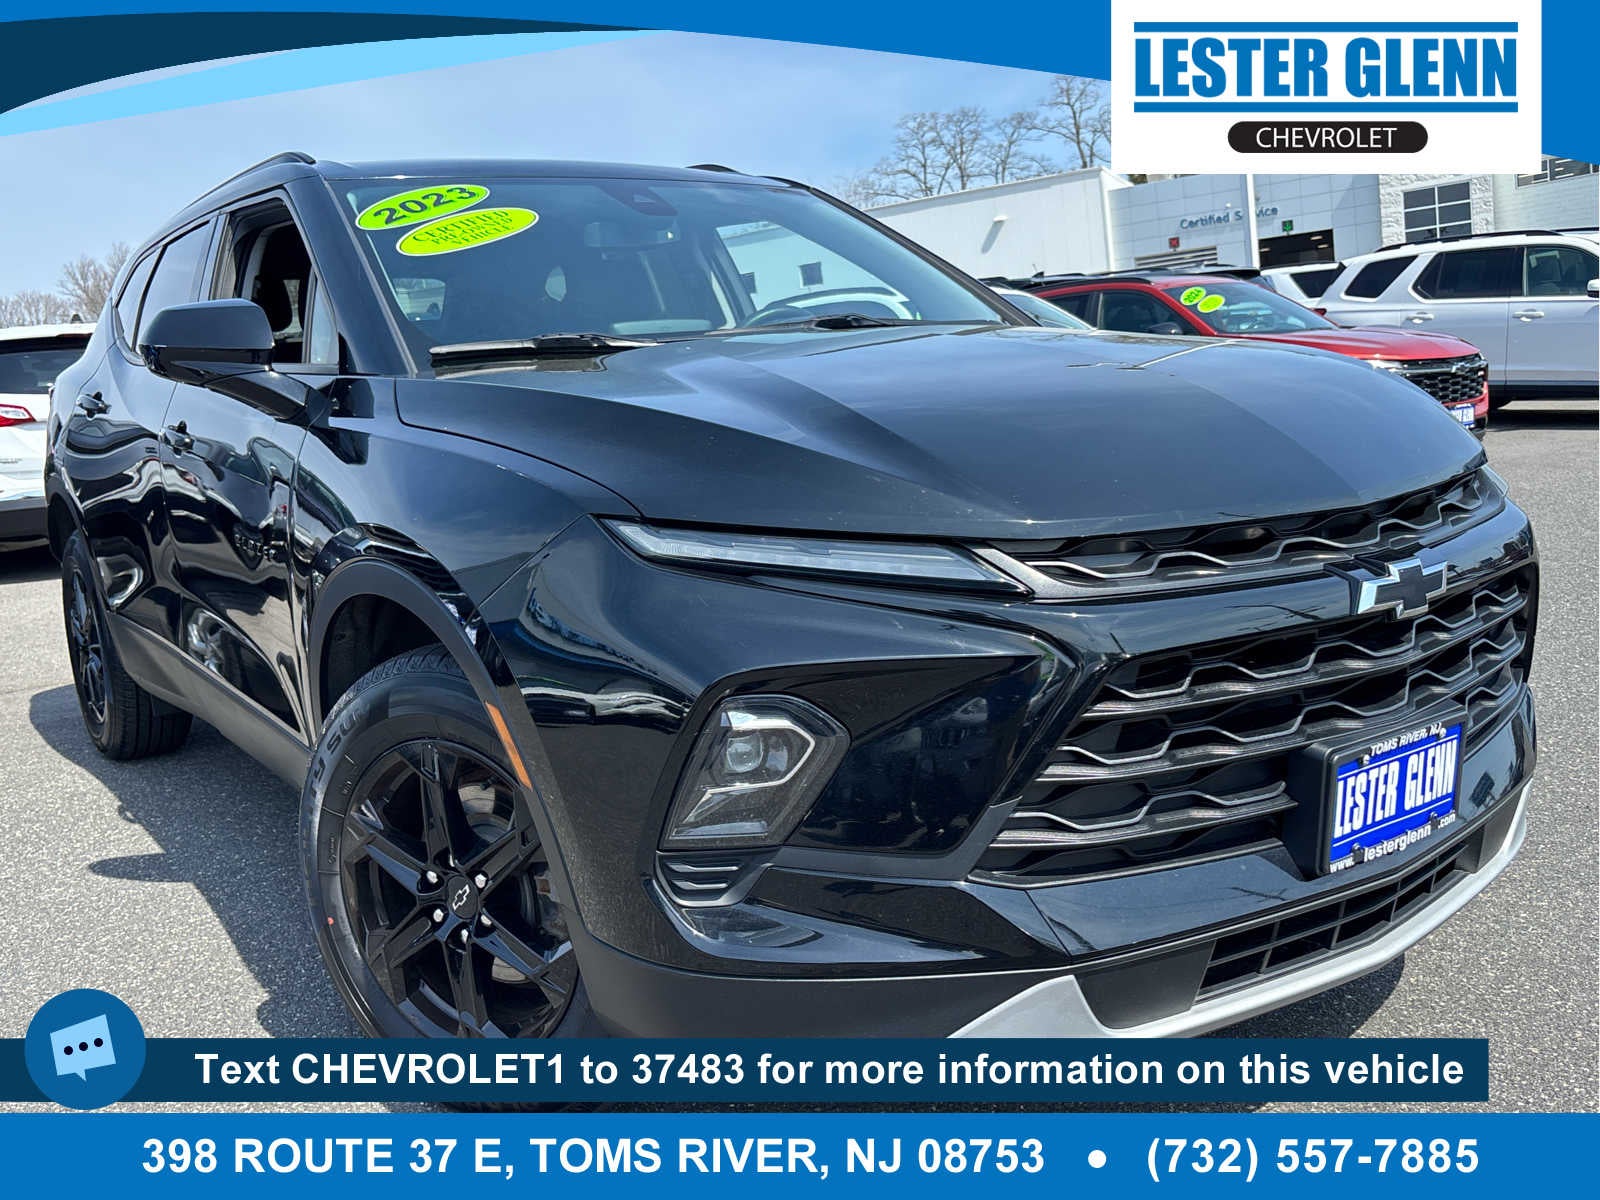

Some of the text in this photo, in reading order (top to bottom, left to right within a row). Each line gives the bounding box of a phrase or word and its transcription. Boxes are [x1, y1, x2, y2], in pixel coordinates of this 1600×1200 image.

[373, 187, 479, 225] 2023
[1180, 206, 1278, 229] Certified Svice
[413, 210, 509, 241] CERTIFIED
[1370, 738, 1398, 757] TOMS
[1429, 721, 1443, 737] NJ
[1333, 739, 1458, 839] LESTER GLENN
